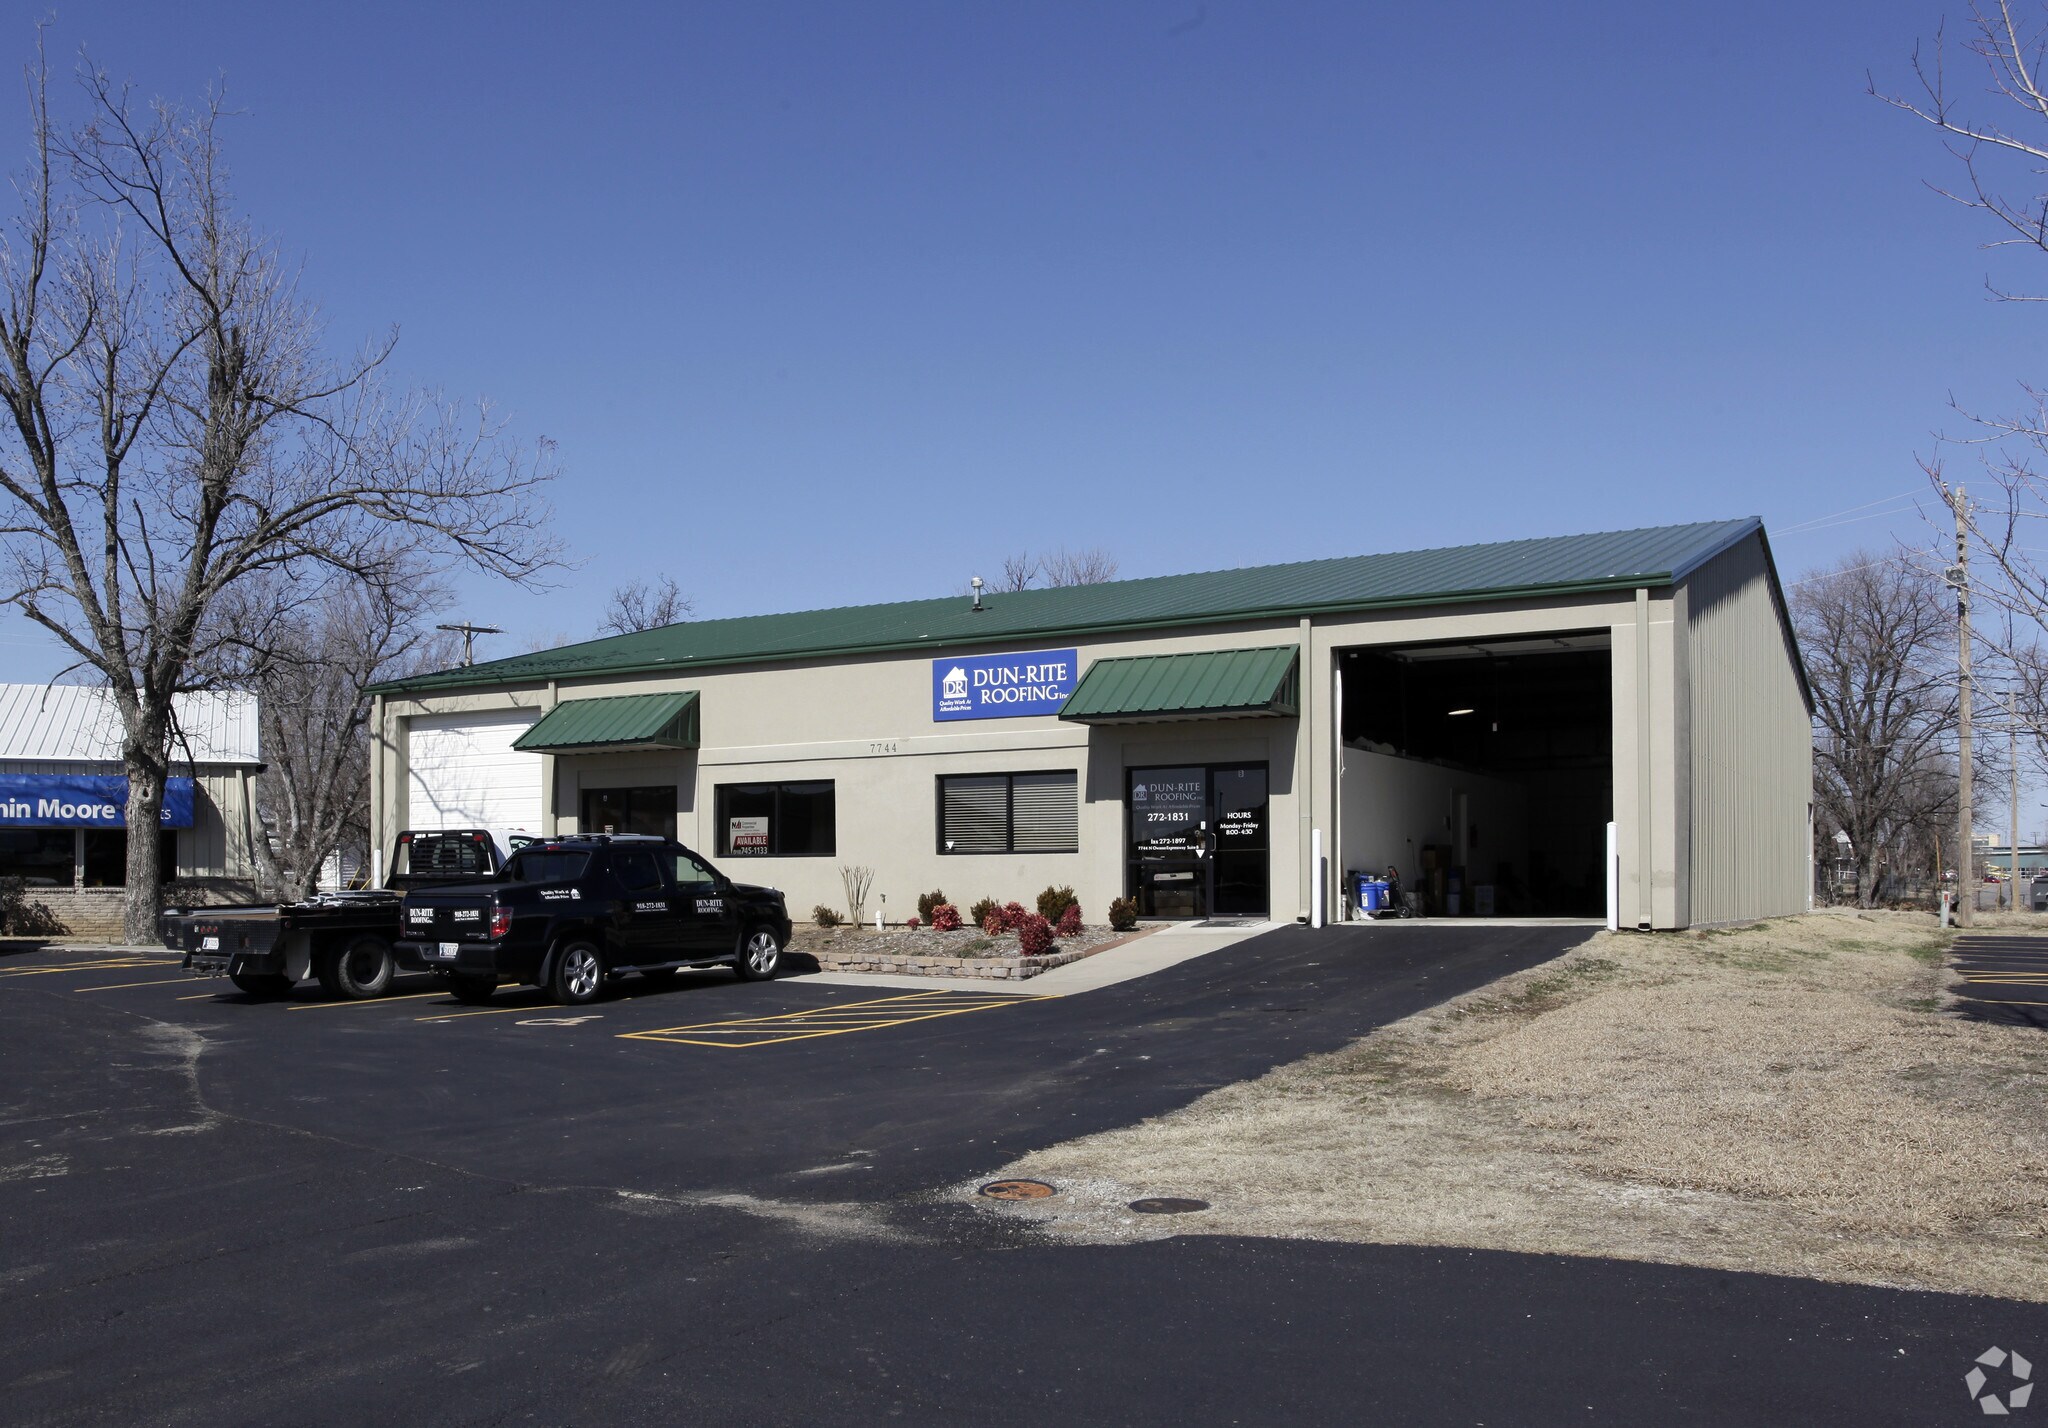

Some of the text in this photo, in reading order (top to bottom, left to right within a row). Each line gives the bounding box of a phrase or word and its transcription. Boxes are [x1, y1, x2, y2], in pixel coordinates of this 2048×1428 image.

[973, 663, 1067, 686] DUN-RITE
[945, 681, 965, 694] DR
[981, 685, 1059, 704] ROOFING
[870, 742, 897, 753] 7744
[1150, 783, 1200, 792] DUN-RITE
[1155, 793, 1197, 801] ROOFING
[37, 799, 116, 819] Moore
[1147, 813, 1189, 822] 272-1831
[736, 836, 767, 845] AVAILABLE
[636, 901, 666, 909] 918-272-1831
[696, 899, 723, 907] DUN-RITE
[410, 908, 433, 916] DUN-RITE
